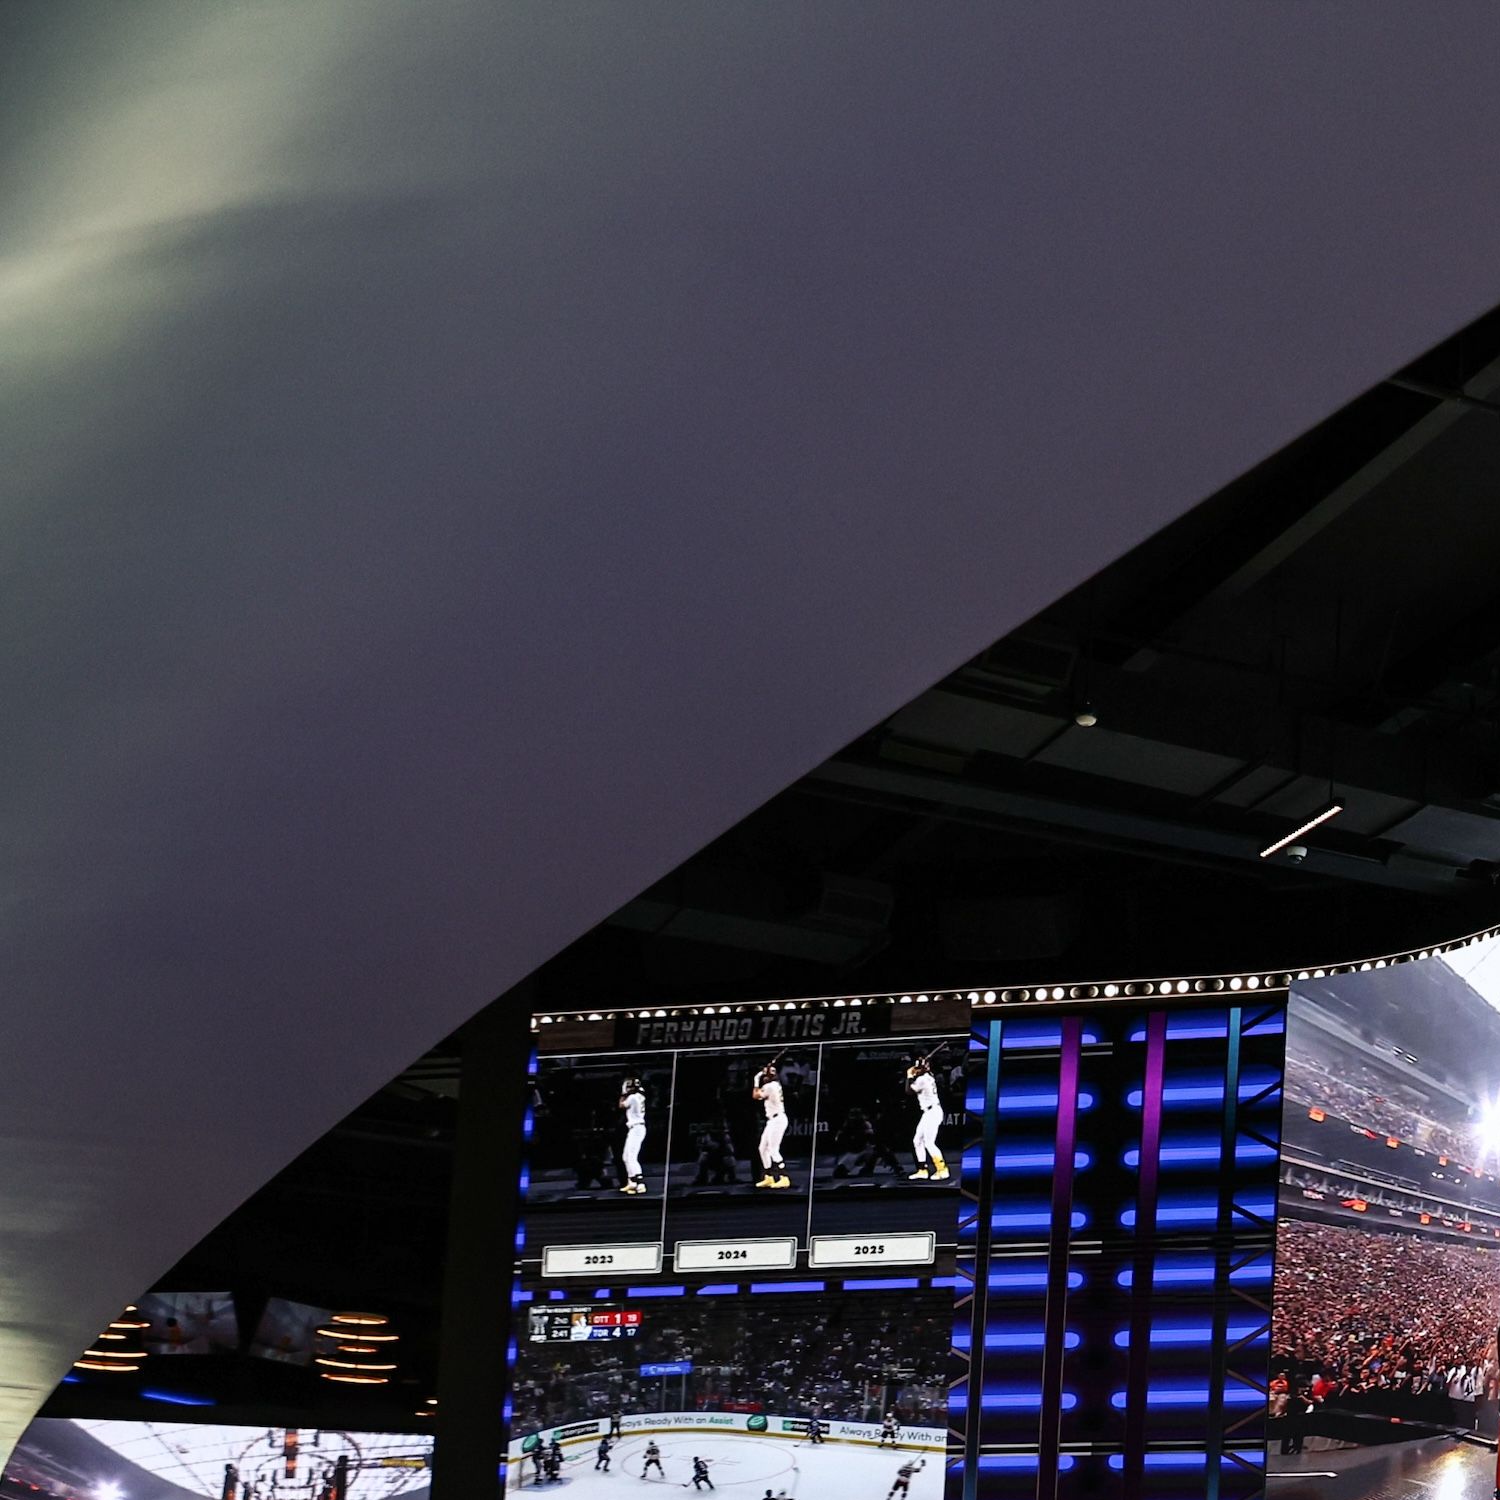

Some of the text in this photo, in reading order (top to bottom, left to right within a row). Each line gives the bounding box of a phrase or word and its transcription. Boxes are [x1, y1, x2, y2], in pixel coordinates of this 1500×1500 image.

[636, 1011, 868, 1046] FERNANDO TATIS JR.
[717, 1249, 748, 1260] 2024
[854, 1244, 885, 1255] 2025
[584, 1254, 614, 1265] 2023
[614, 1313, 621, 1325] 1
[612, 1326, 621, 1338] 4
[644, 1416, 673, 1426] Ready
[674, 1415, 694, 1425] With
[840, 1426, 873, 1439] Always
[908, 1431, 933, 1442] With
